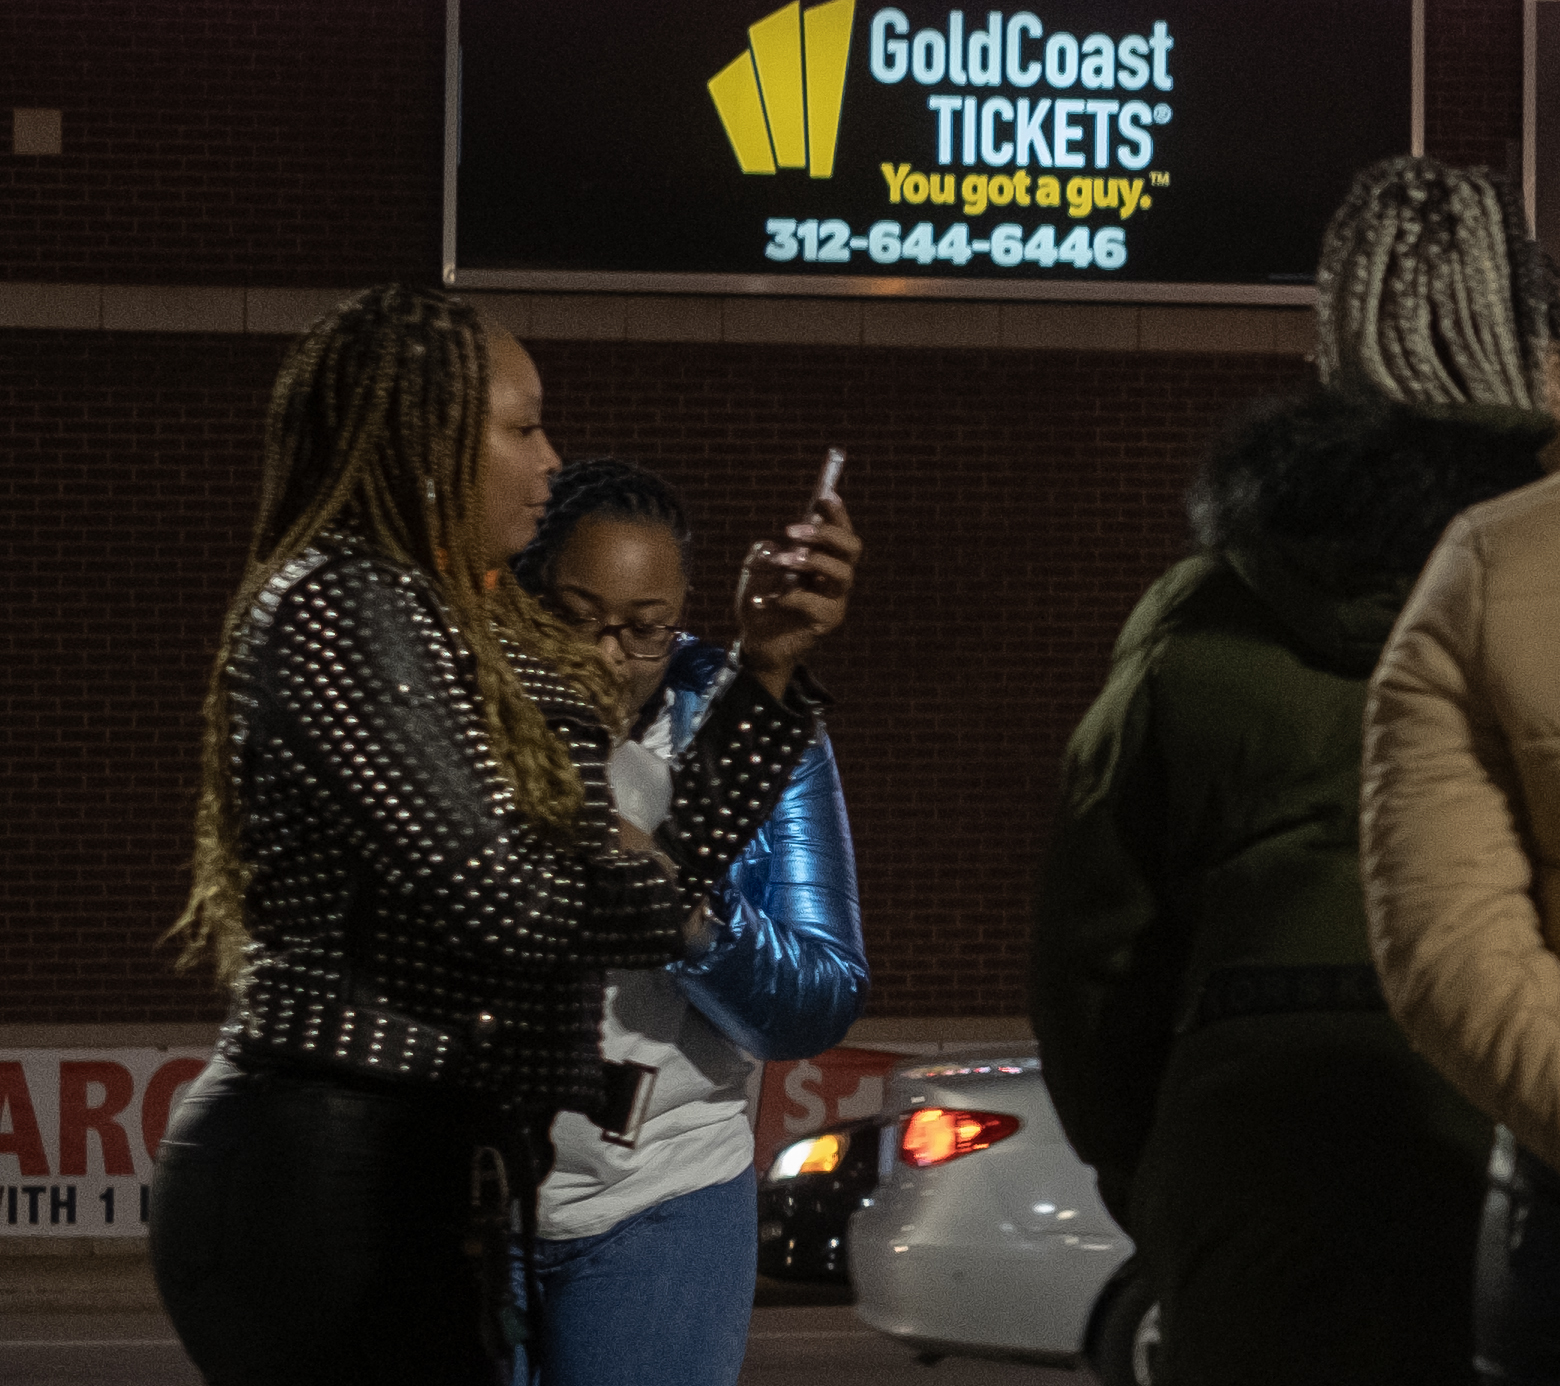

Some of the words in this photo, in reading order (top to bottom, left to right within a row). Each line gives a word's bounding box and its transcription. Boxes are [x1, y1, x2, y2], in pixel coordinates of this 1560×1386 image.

[869, 7, 1174, 91] GoldCoast
[880, 162, 955, 204] You
[961, 169, 1032, 216] got
[1035, 175, 1061, 208] a
[764, 216, 1131, 270] 312-644-6446
[0, 1186, 77, 1225] ITH
